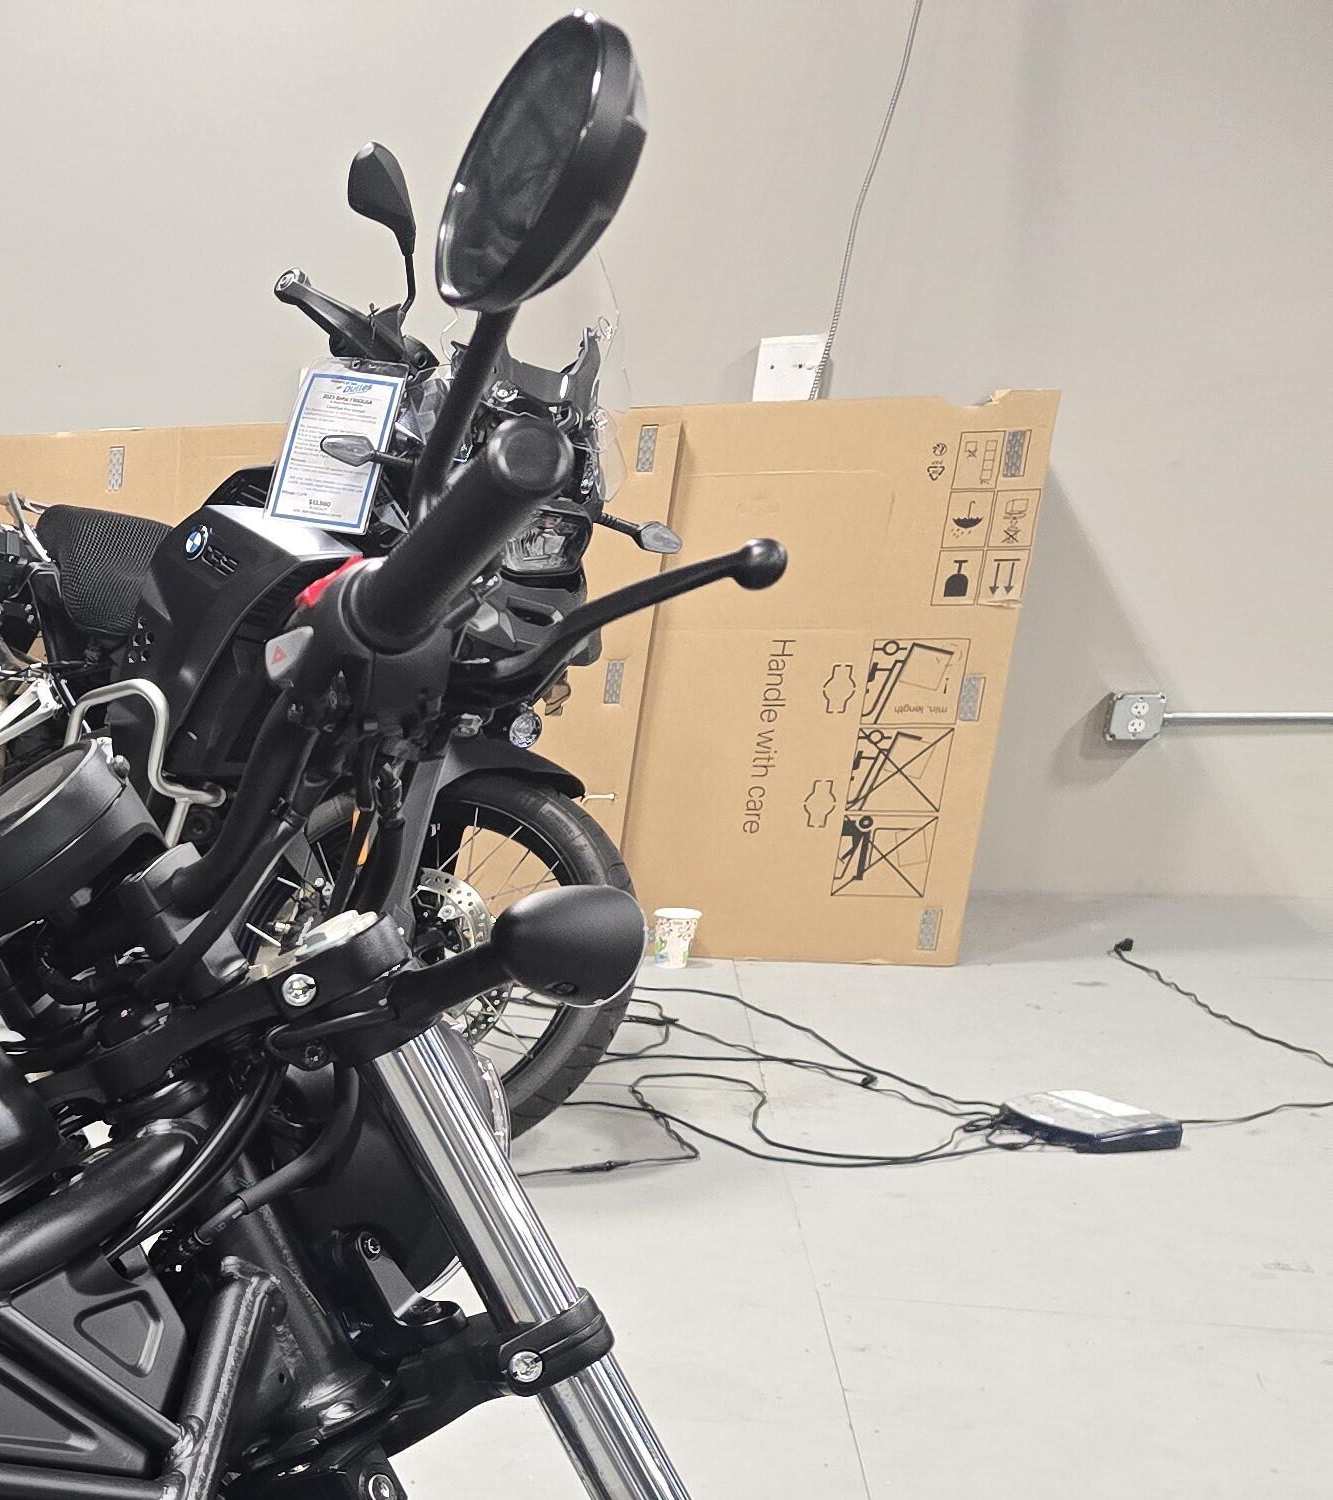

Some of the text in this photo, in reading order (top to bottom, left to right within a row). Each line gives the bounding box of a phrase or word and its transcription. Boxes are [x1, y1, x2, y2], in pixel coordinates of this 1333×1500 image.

[742, 639, 797, 834] Handle with care
[894, 704, 925, 714] length
